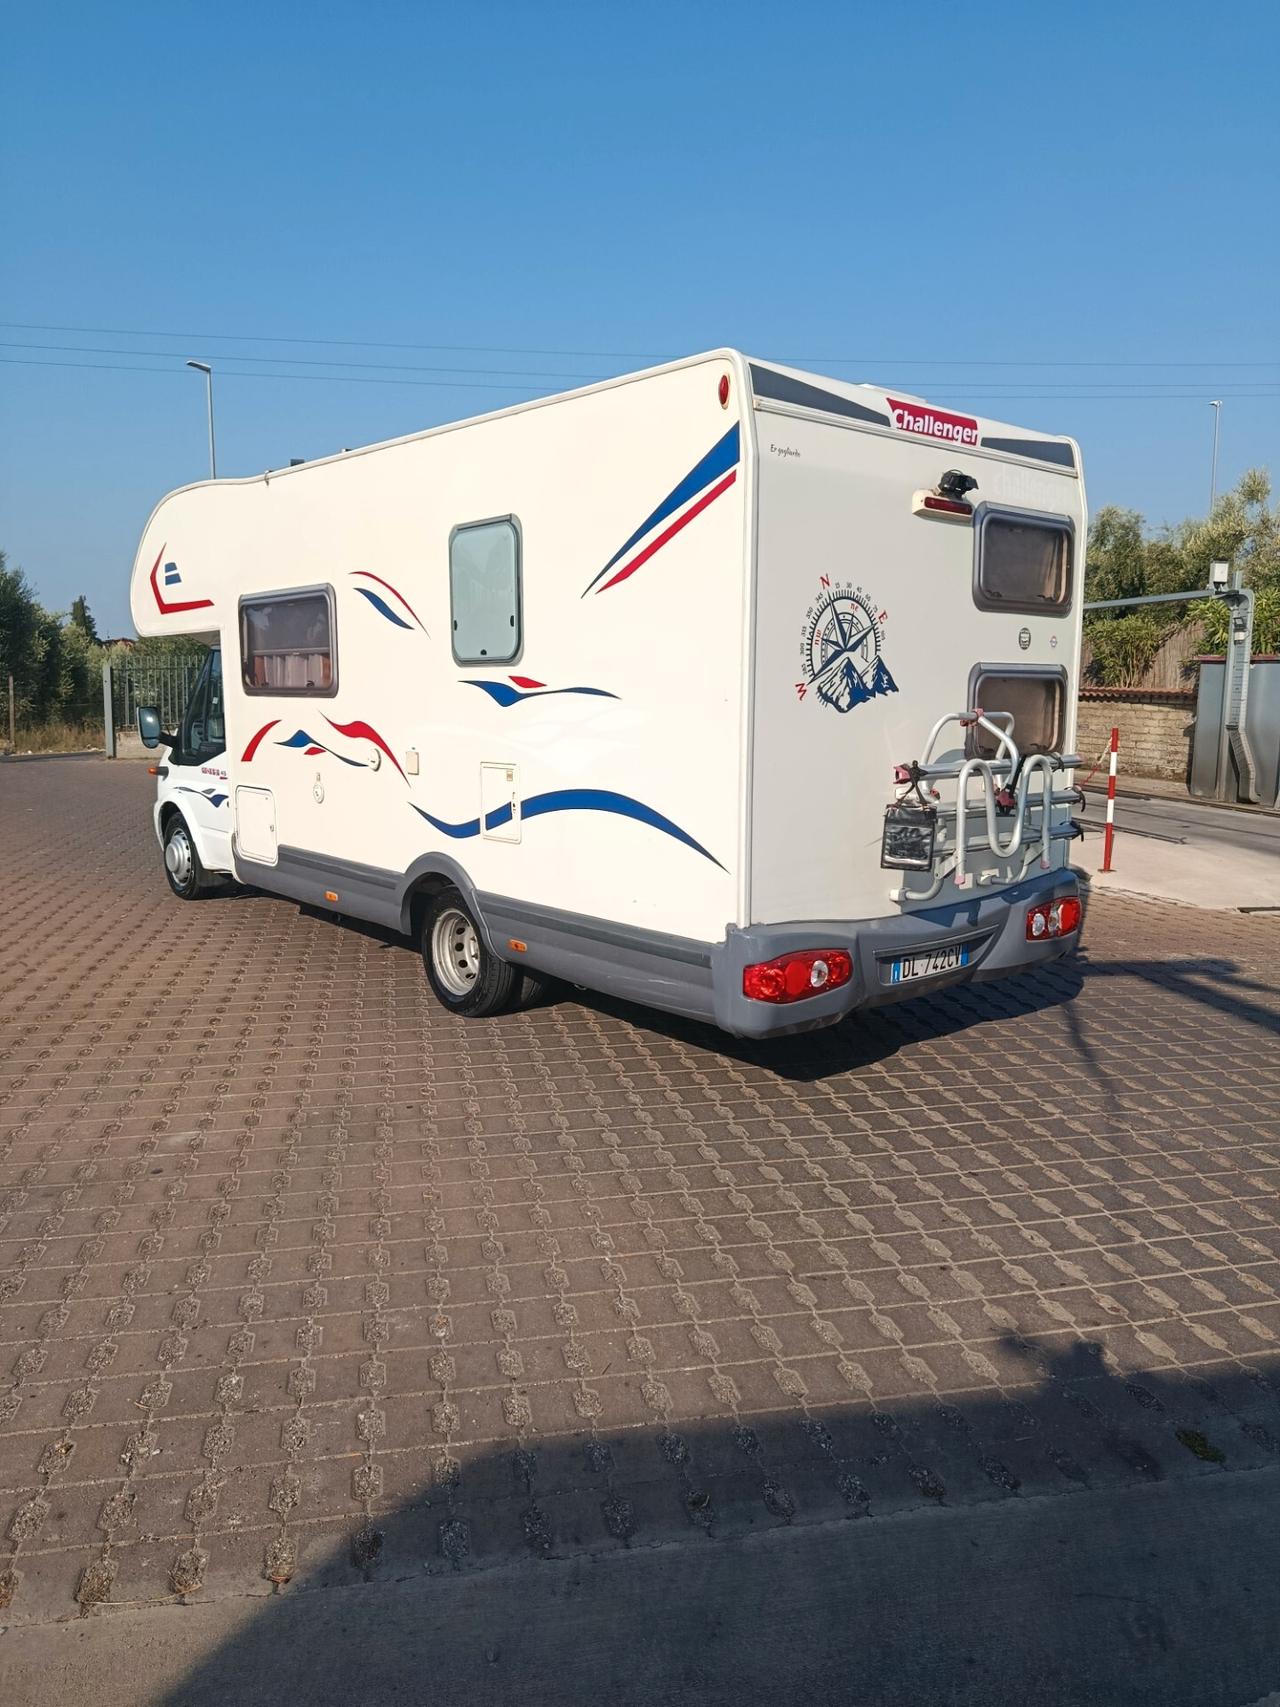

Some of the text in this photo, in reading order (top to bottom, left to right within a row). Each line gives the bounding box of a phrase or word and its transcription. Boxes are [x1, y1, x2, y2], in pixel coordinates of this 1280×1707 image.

[893, 408, 979, 445] Challenger
[820, 573, 830, 590] N
[878, 610, 888, 625] E
[902, 956, 919, 978] DL
[924, 945, 961, 974] 742CV
